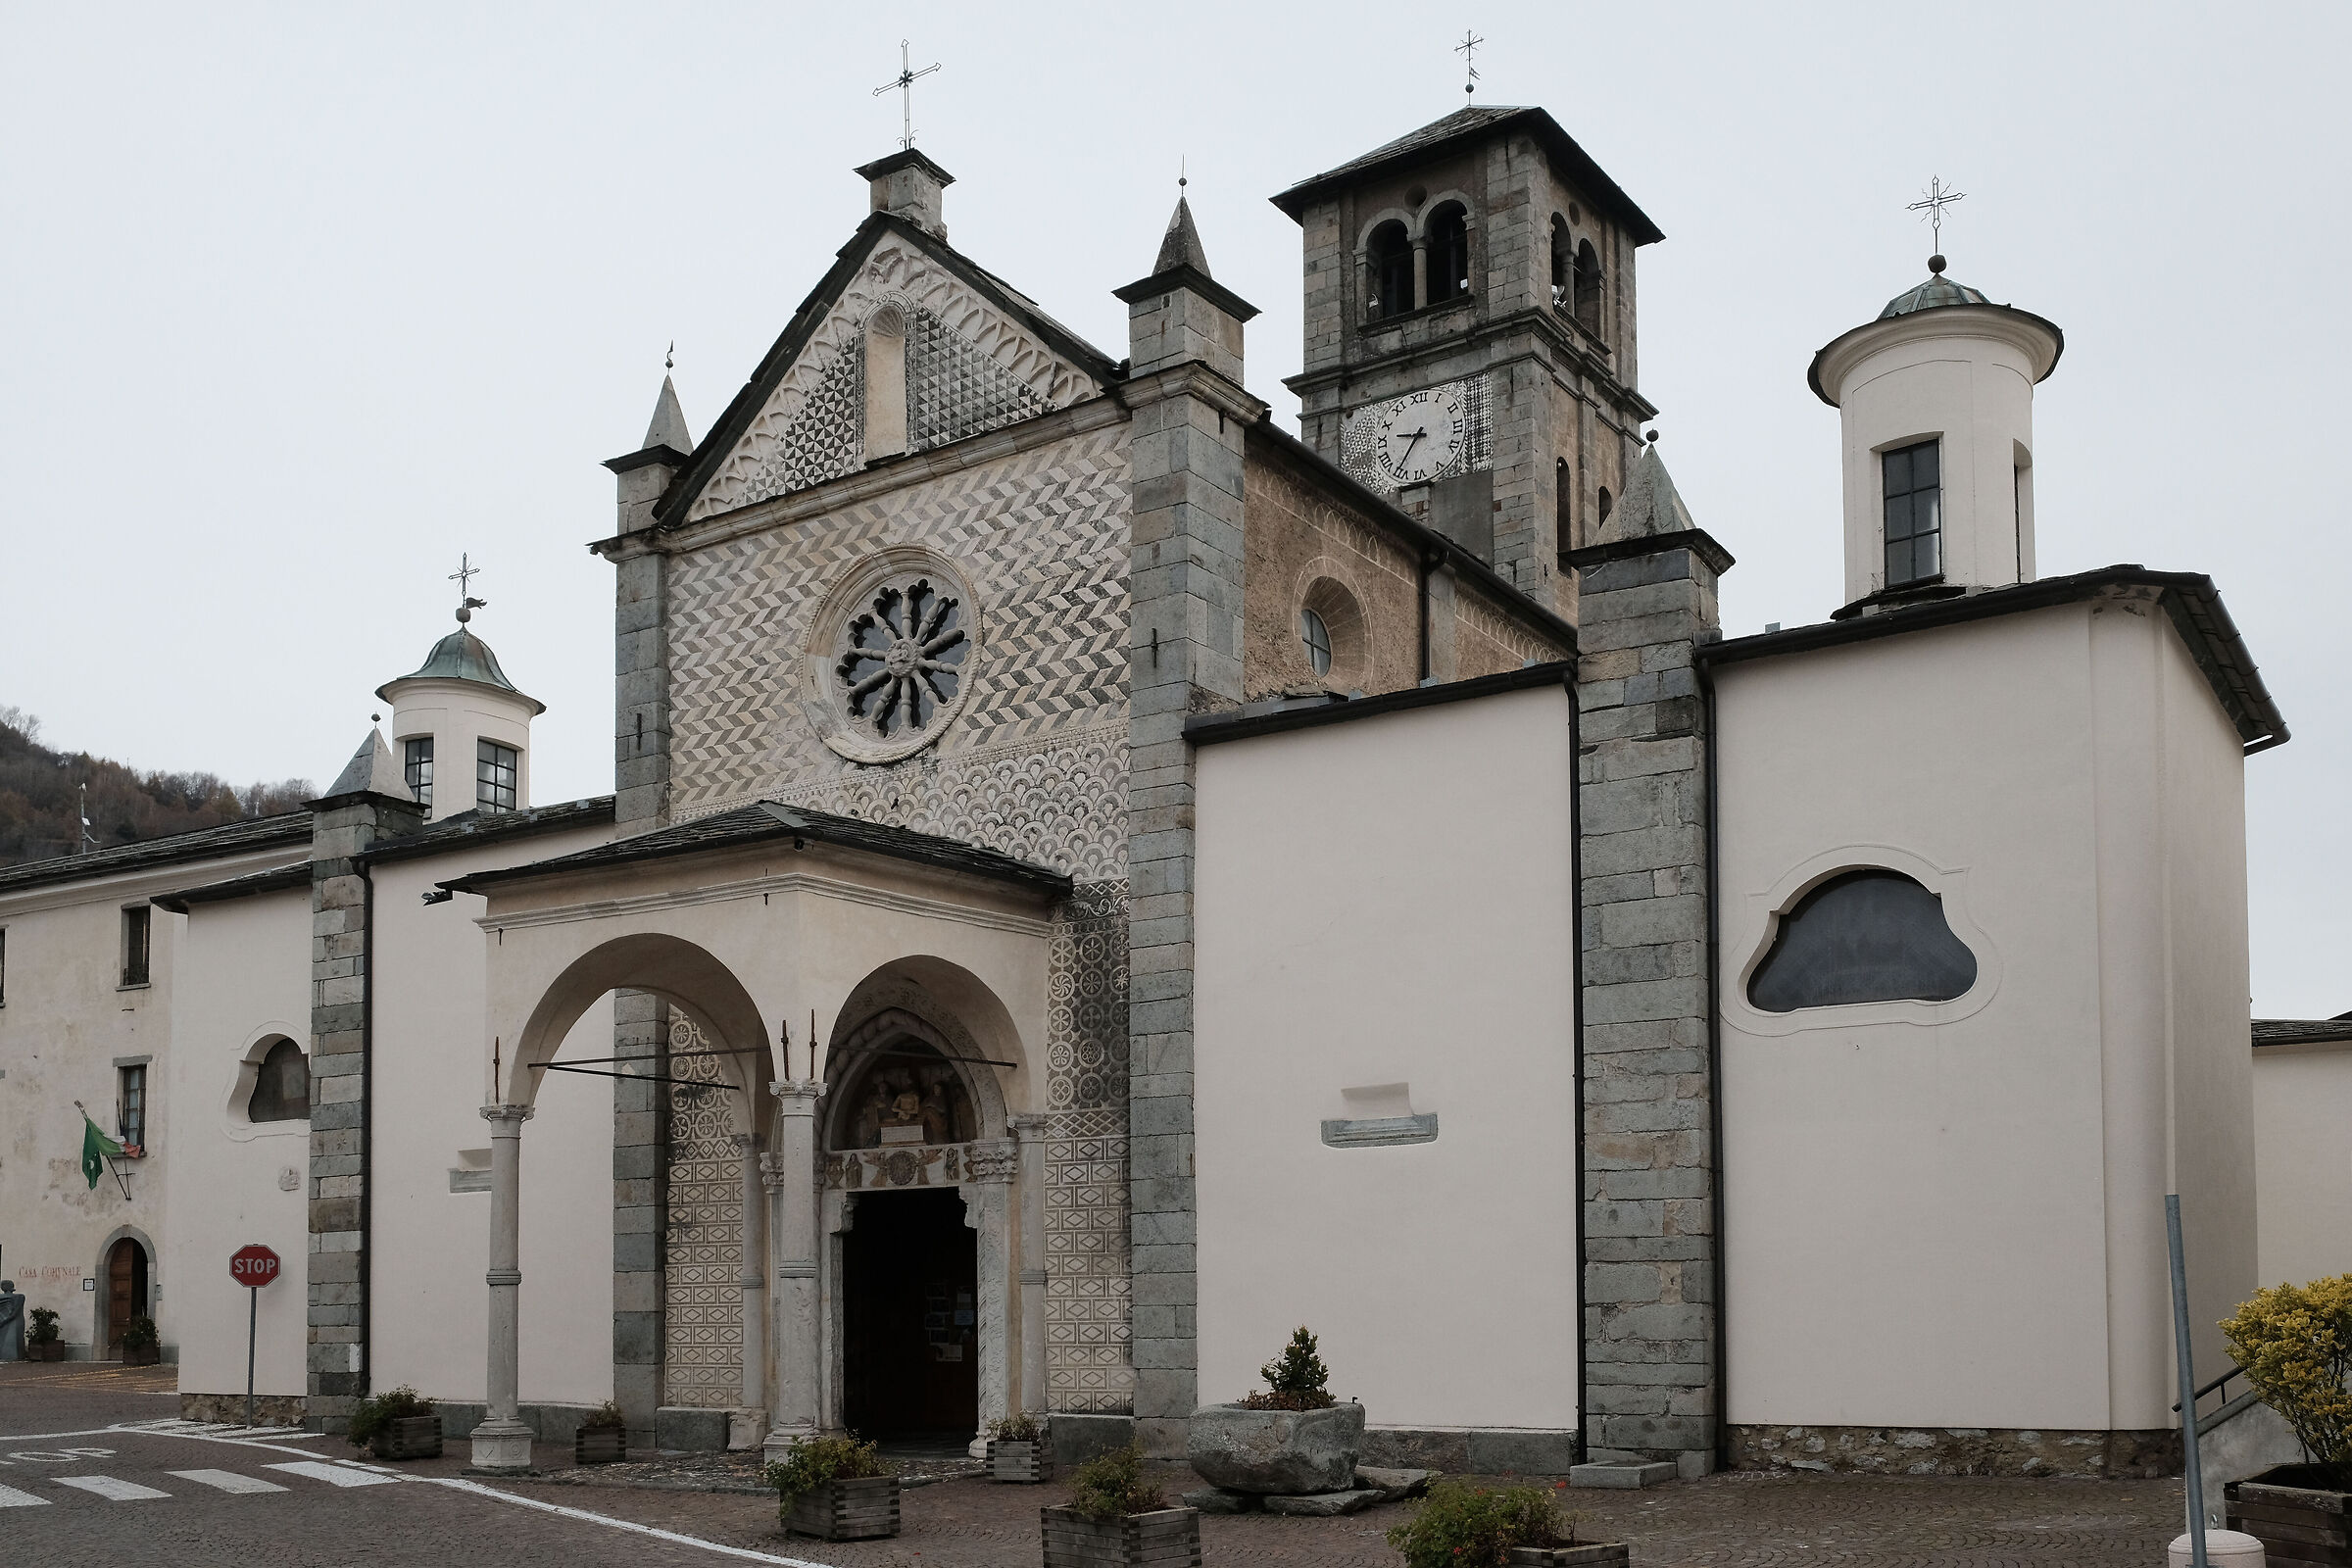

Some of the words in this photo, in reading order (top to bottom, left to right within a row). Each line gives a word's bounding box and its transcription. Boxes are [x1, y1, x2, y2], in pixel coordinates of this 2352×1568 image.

[1410, 392, 1428, 405] XII
[1435, 393, 1443, 403] I
[1392, 401, 1406, 416] XI
[1446, 402, 1458, 414] II
[1382, 420, 1393, 430] X
[1452, 418, 1462, 434] III
[1378, 435, 1387, 449] IX
[1448, 440, 1460, 454] IV
[1378, 452, 1394, 472] VIII
[1436, 461, 1445, 471] V
[1393, 467, 1408, 479] VII
[1414, 469, 1427, 480] VI
[234, 1258, 276, 1274] STOP
